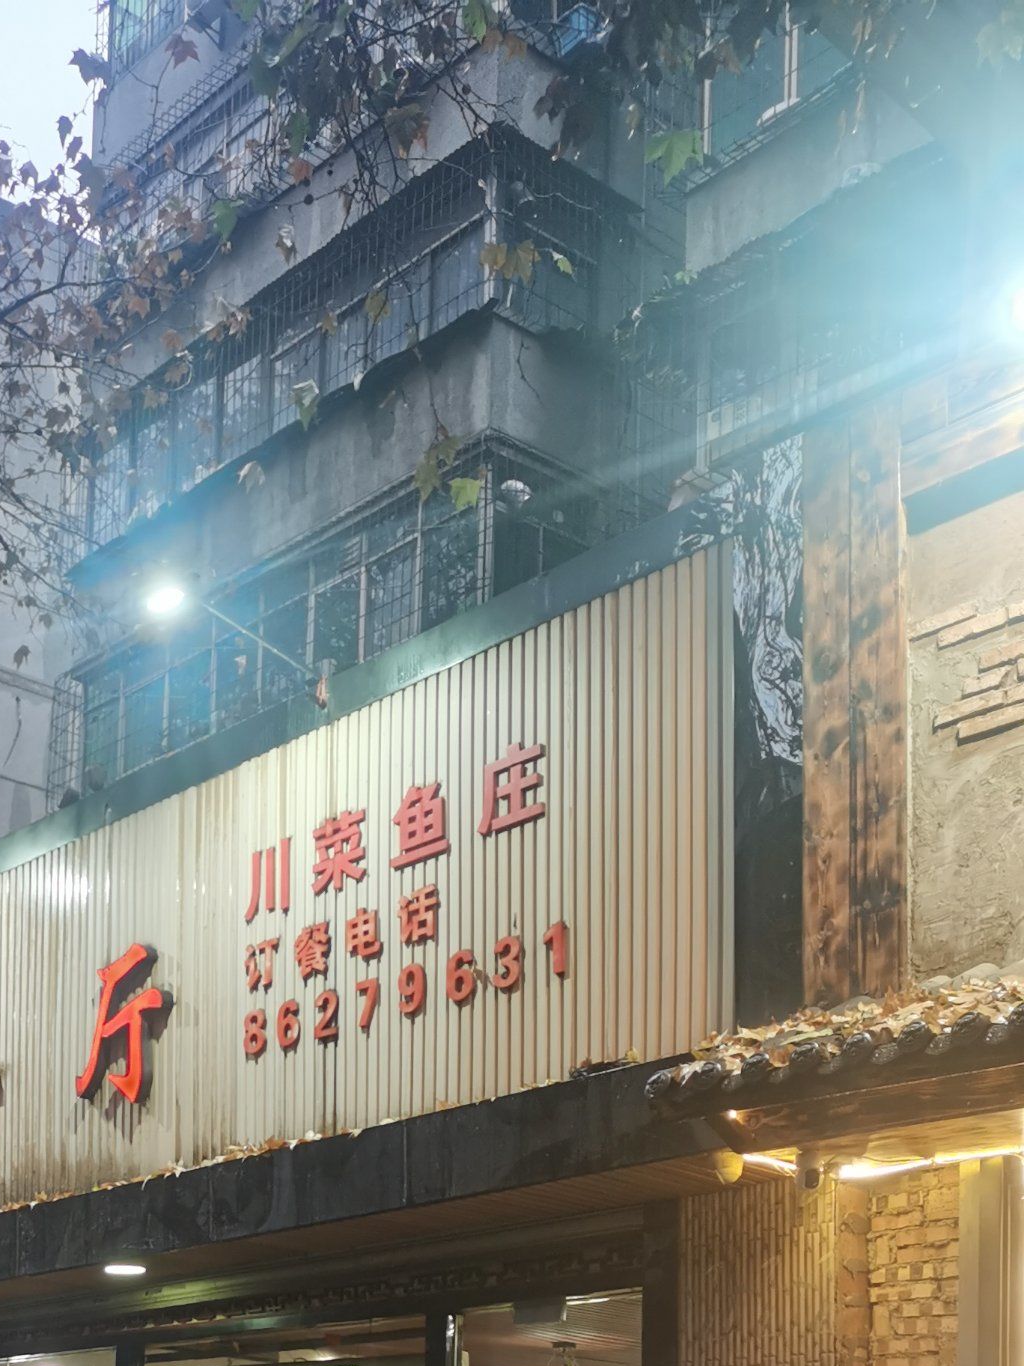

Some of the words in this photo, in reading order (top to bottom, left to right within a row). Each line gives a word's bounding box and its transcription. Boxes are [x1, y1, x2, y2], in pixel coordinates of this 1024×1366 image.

[244, 742, 546, 923] 川菜鱼庄
[243, 921, 570, 1056] 86279631
[244, 884, 439, 991] 订餐电话
